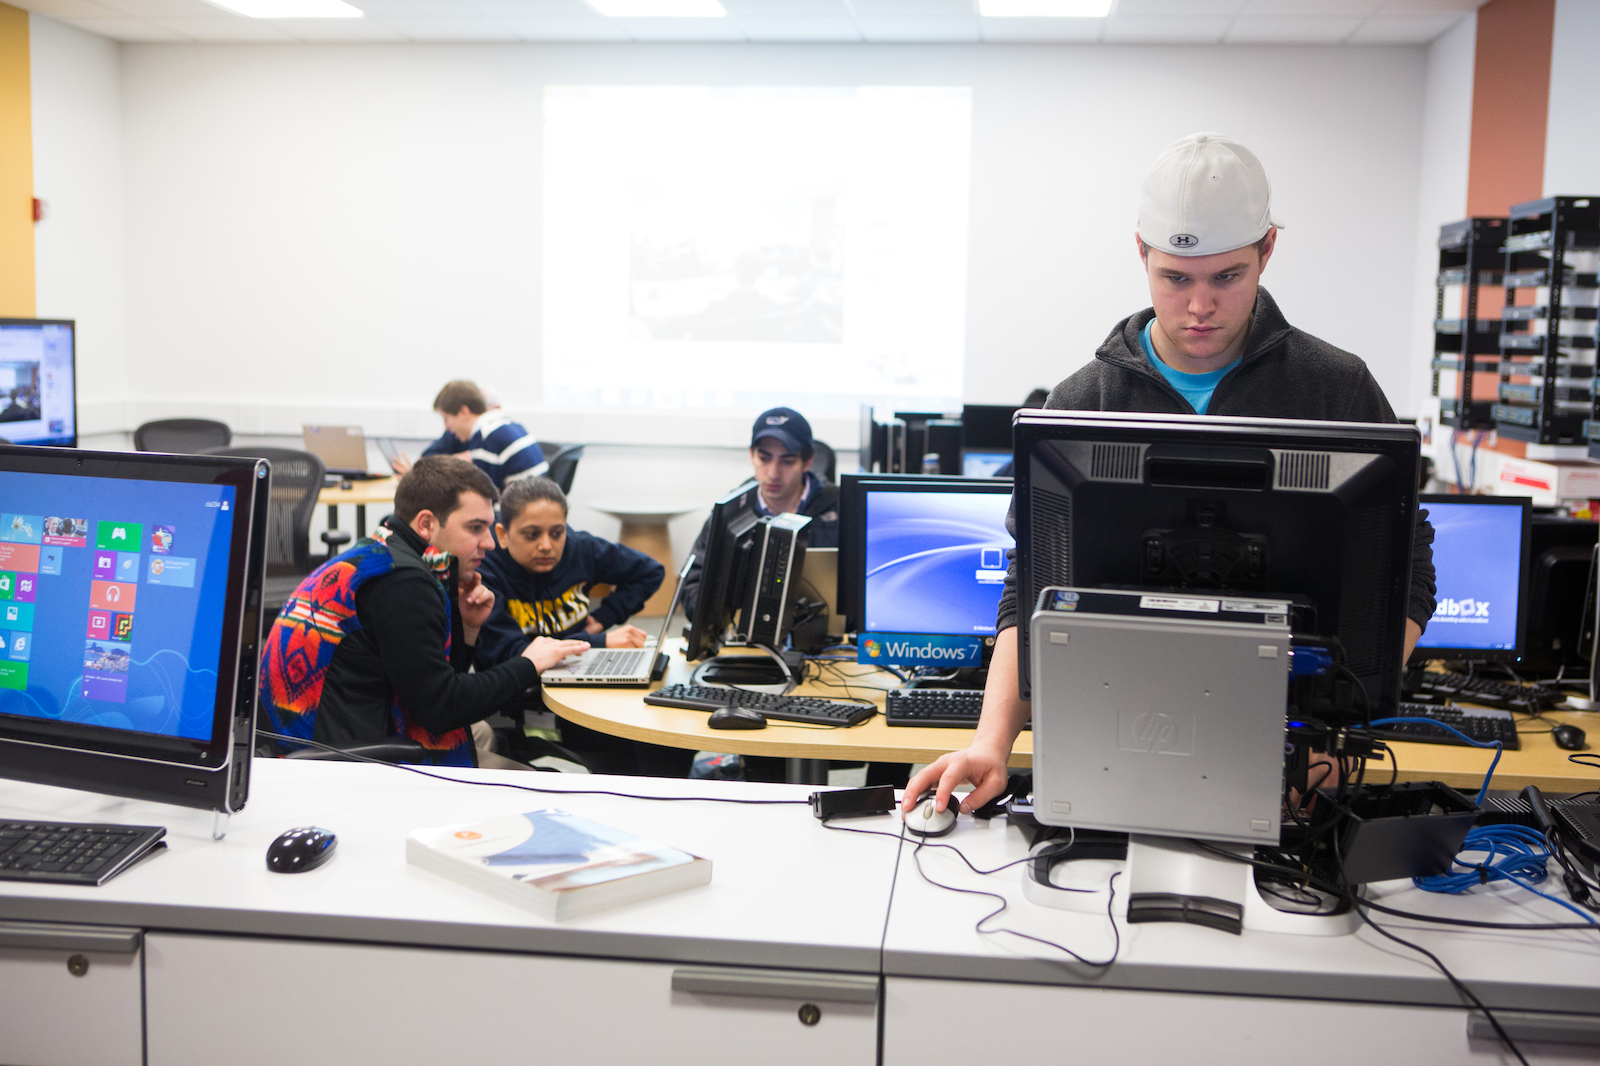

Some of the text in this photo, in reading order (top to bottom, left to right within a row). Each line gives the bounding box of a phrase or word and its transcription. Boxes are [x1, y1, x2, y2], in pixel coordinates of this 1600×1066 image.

[1436, 598, 1490, 617] dbox
[886, 642, 979, 660] Windows 7
